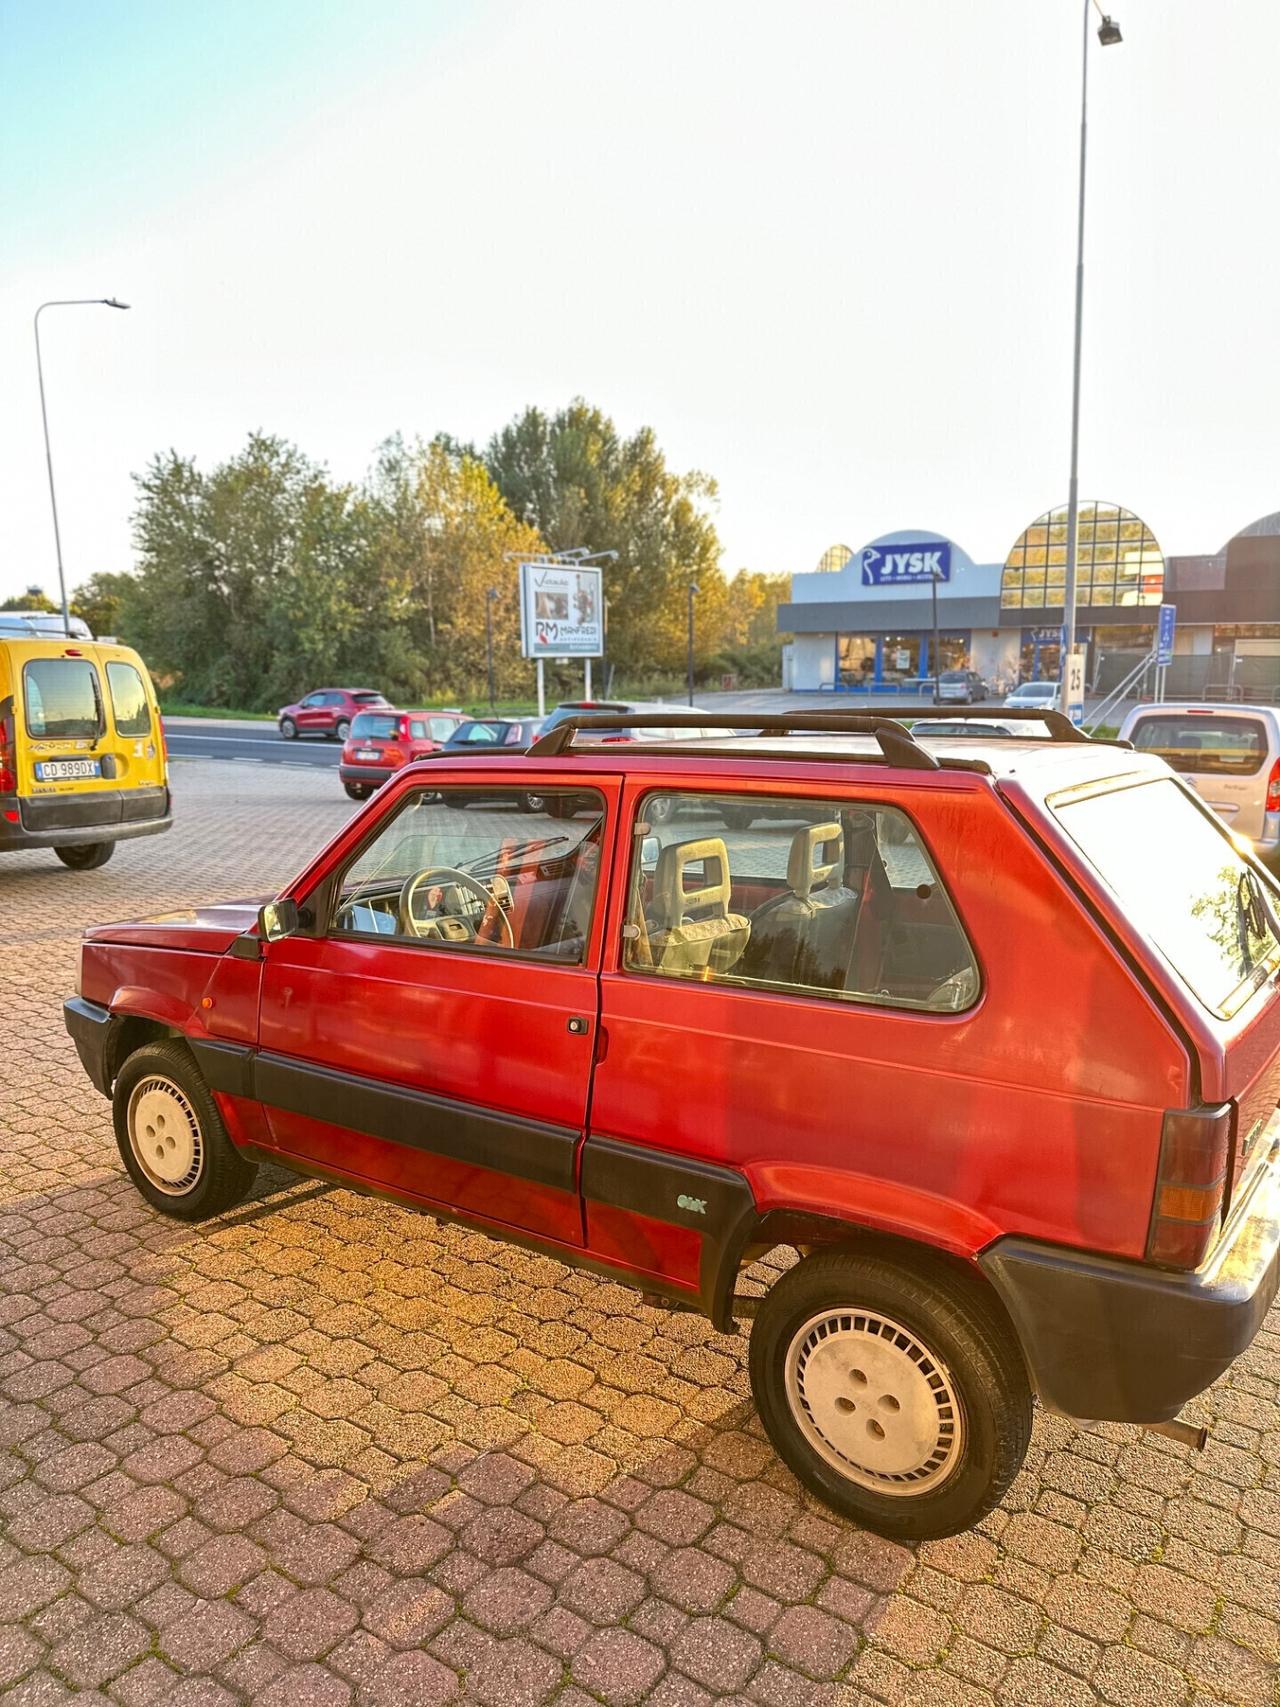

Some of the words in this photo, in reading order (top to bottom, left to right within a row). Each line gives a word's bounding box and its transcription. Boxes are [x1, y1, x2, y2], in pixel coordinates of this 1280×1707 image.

[880, 551, 944, 576] JYSK
[1071, 669, 1081, 691] 25
[43, 763, 58, 777] CD
[60, 761, 94, 776] 989DX
